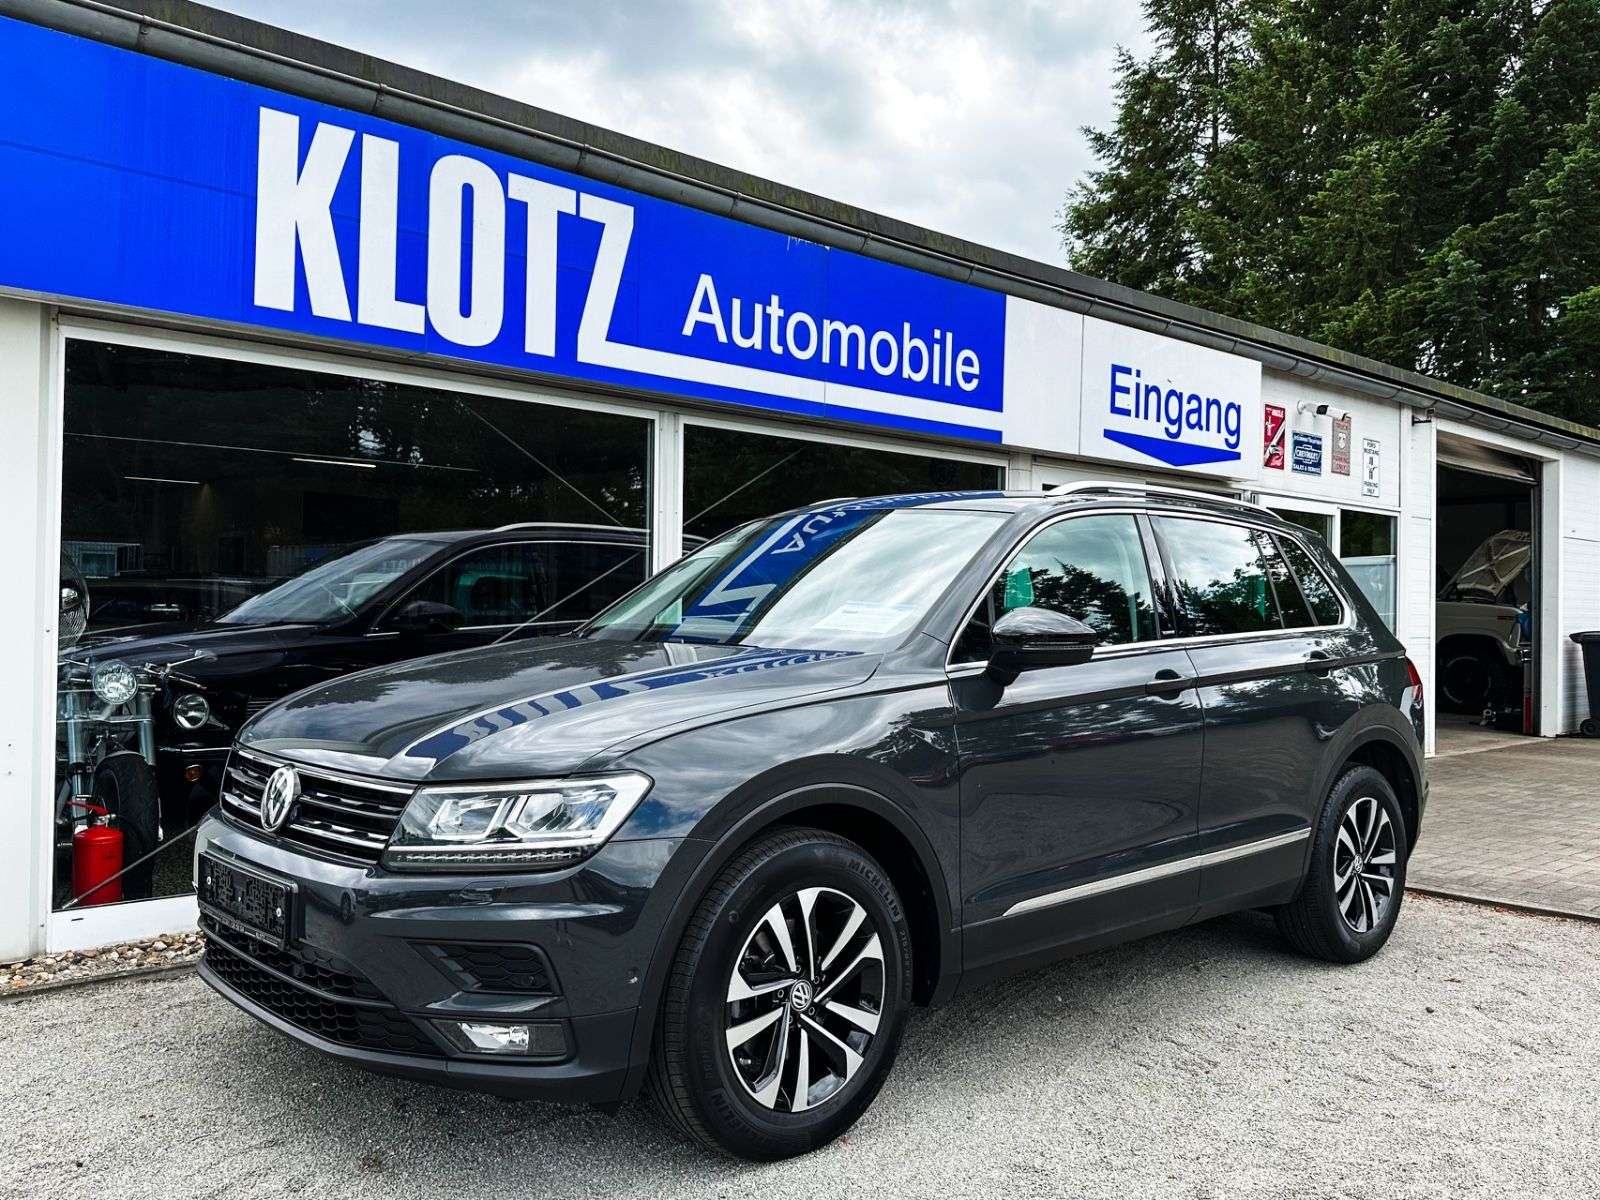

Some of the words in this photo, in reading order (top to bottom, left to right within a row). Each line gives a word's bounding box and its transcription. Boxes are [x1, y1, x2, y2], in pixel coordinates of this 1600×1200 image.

[254, 107, 635, 364] KLOTZ
[682, 273, 981, 392] Automobile
[1109, 363, 1242, 449] Eingang
[847, 858, 902, 922] MICHELIN
